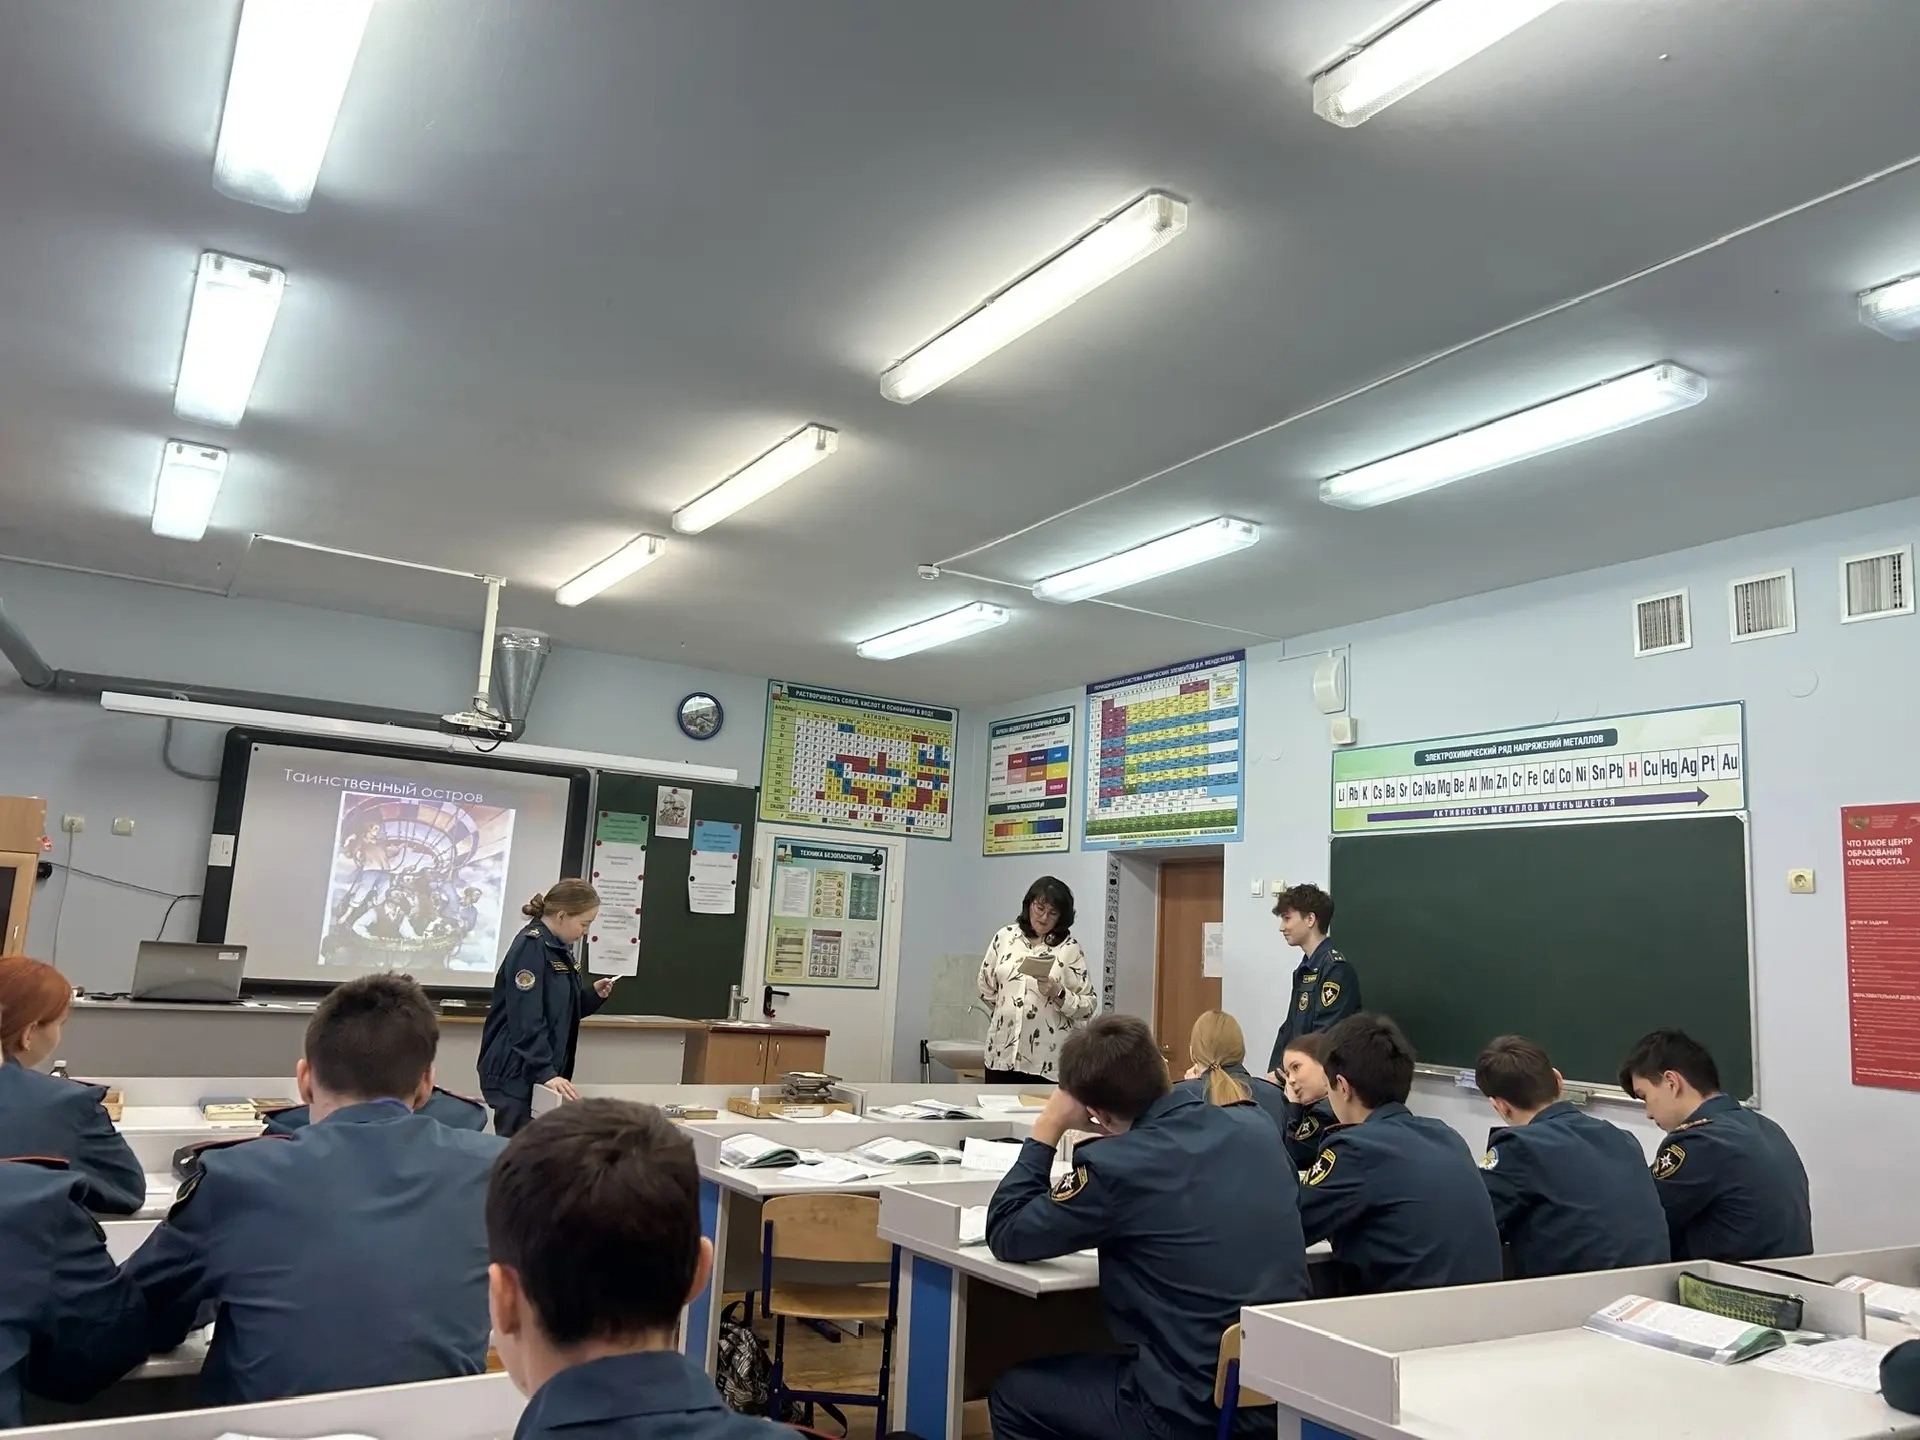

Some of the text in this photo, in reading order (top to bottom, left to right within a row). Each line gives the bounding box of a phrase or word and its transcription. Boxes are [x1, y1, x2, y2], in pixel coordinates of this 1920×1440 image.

[1125, 676, 1143, 684] СИСТЕМА
[1205, 655, 1235, 666] МЕНДЕЛЕЕВА
[795, 691, 840, 703] РАСТВОРИМОСТЬ
[860, 701, 881, 709] КИСЛОТ
[1424, 734, 1604, 762] ЭЛЕКТРОХИМИЧЕСКИЙ РЯД НАПРЯЖЕНИЙ МЕТАЛЛОВ
[284, 768, 484, 803] Таинственный остров
[1339, 754, 1737, 801] Li Rb K Cs Ba Sr Ca Na Mg Be Al Mn Zn Cr Fe Cd Co Ni Sn Pb H Cu Hg Ag Pt Au
[1433, 798, 1616, 817] АКТИВНОСТЬ МЕТАЛЛОВ УМЕНЬШАЕТСЯ
[1847, 838, 1913, 847] ЧТО ТАКОЕ ЦЕНТР
[800, 849, 863, 861] ТЕХНИКА БЕЗОПАСНОСТИ
[1847, 848, 1903, 857] ОБРАЗОВАНИЯ
[1876, 857, 1910, 866] РОСТА»?
